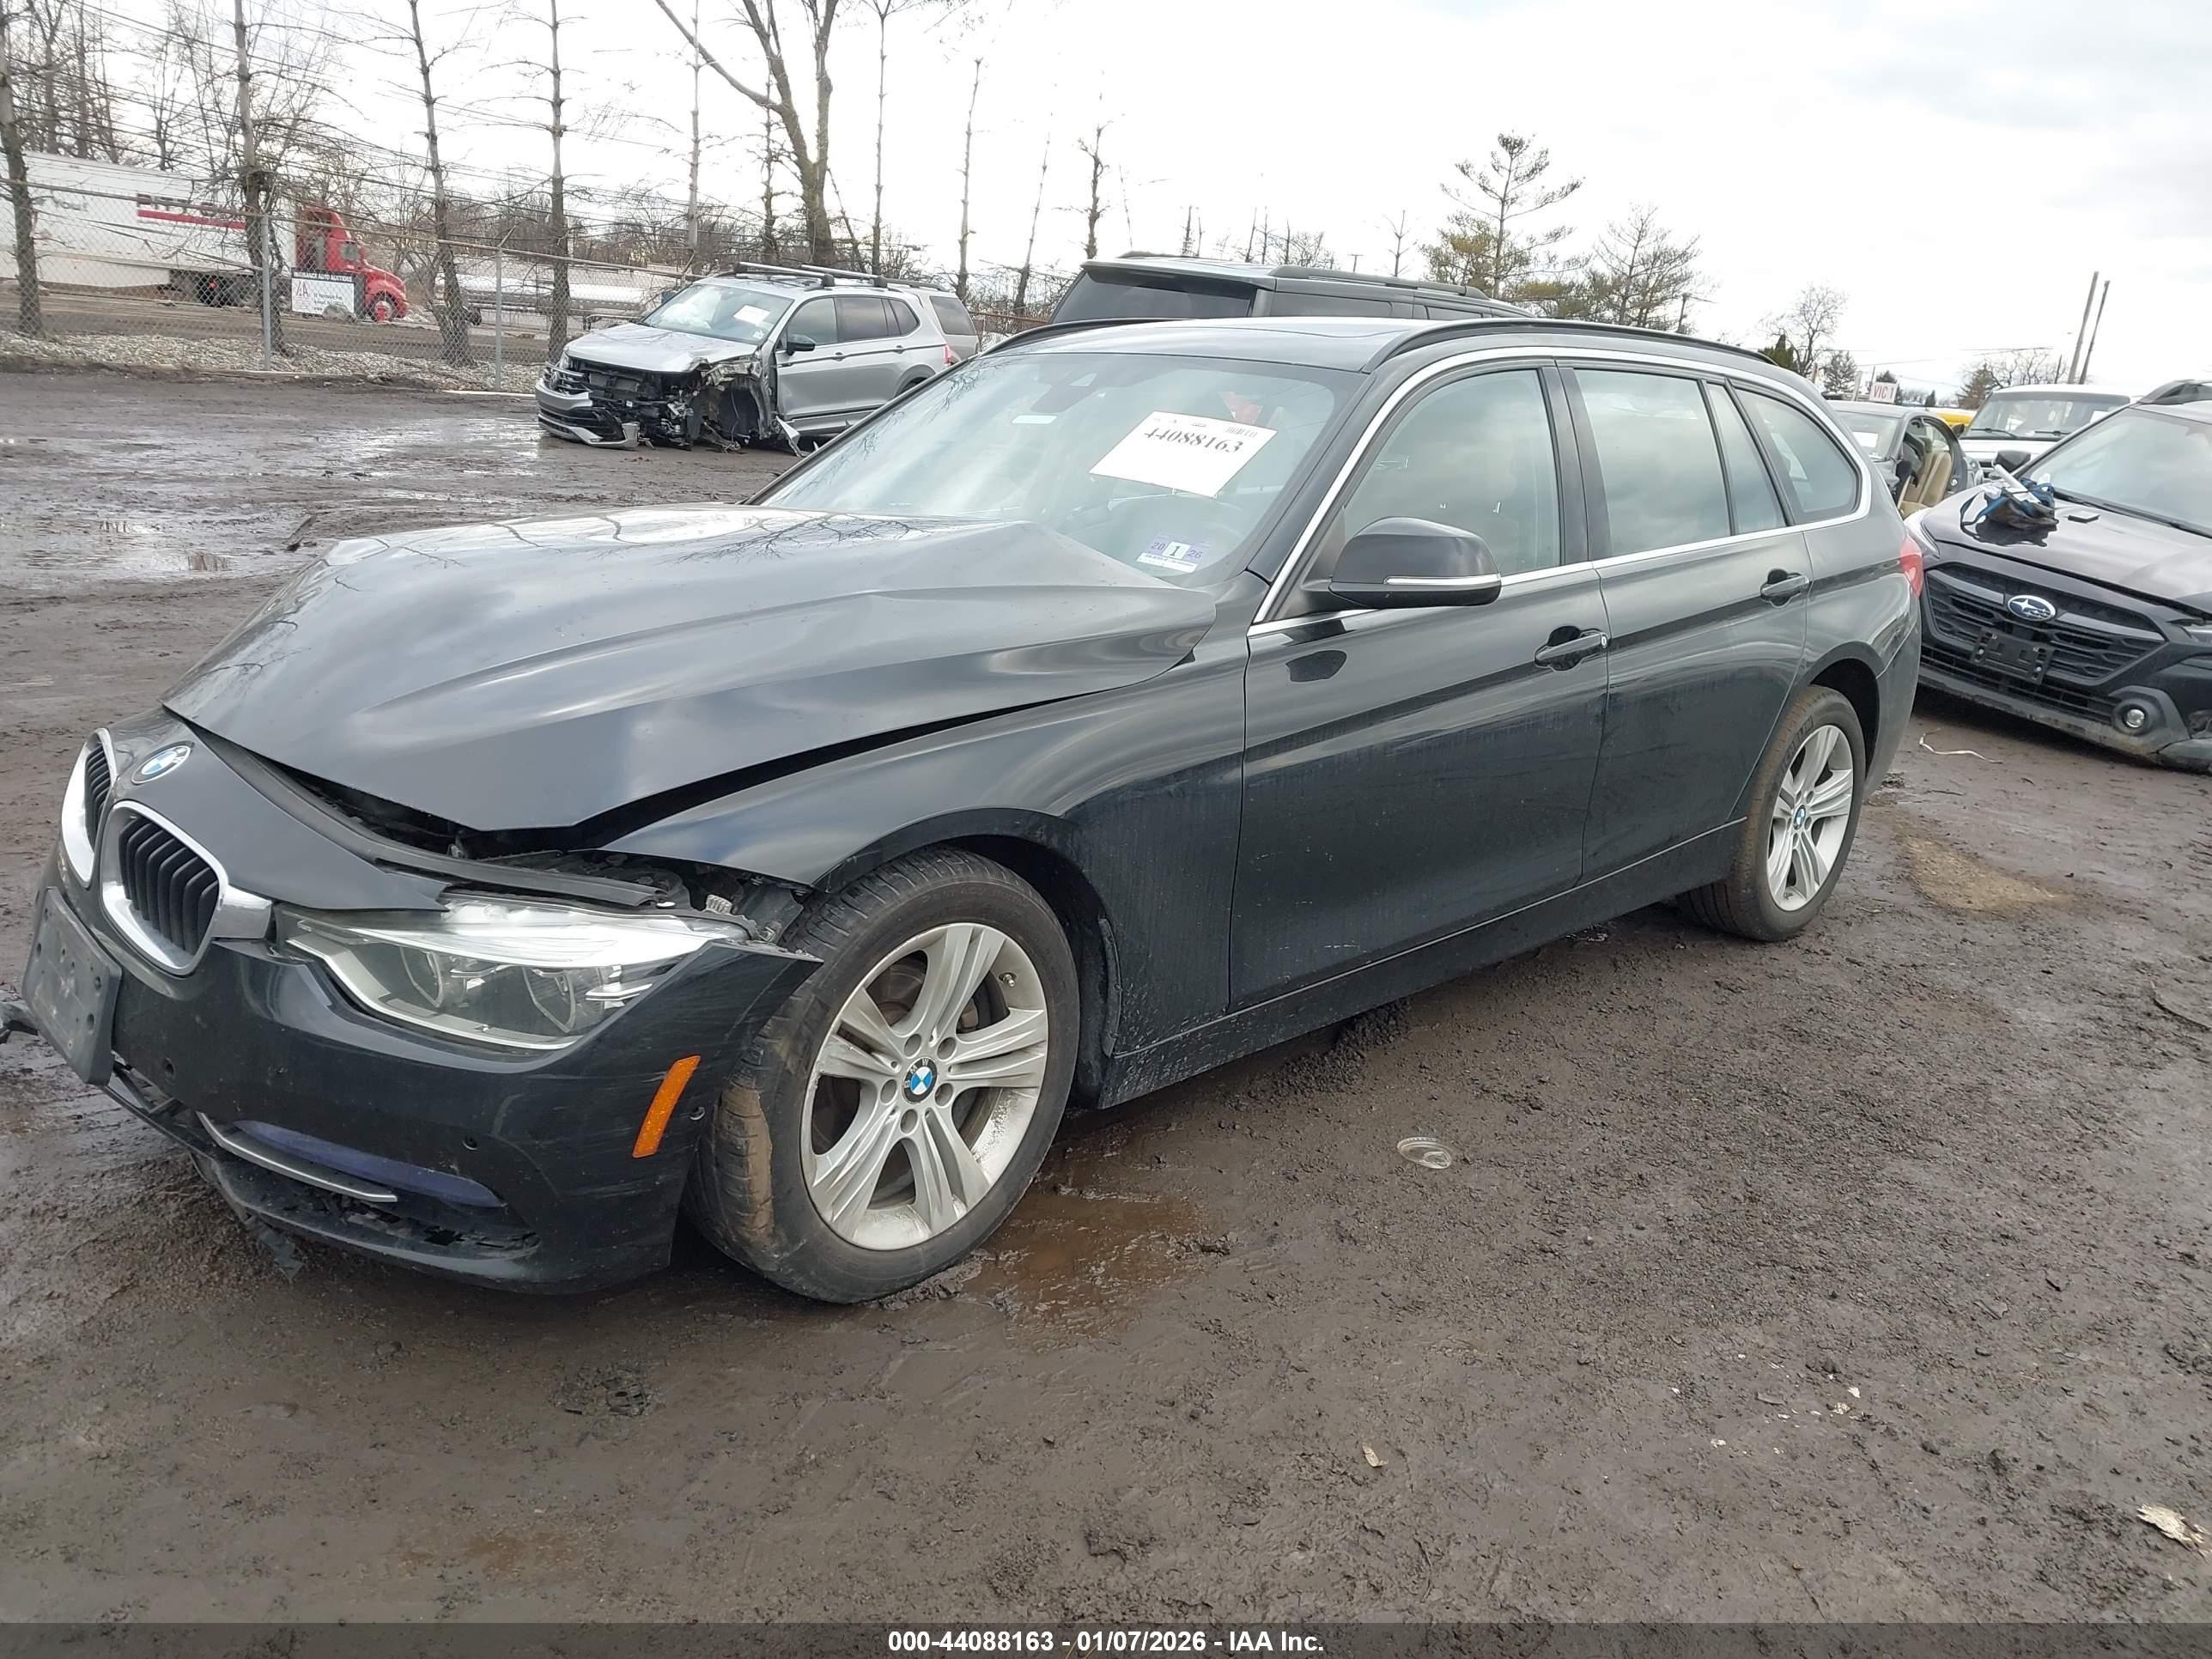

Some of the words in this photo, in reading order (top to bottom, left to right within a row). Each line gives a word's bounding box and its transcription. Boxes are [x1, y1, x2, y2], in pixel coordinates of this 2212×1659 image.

[1874, 385, 1888, 399] VIC
[1144, 428, 1244, 453] 44088163
[1152, 542, 1166, 550] 20
[1170, 545, 1181, 556] 1
[1188, 550, 1203, 559] 26
[903, 1057, 929, 1090] BMW
